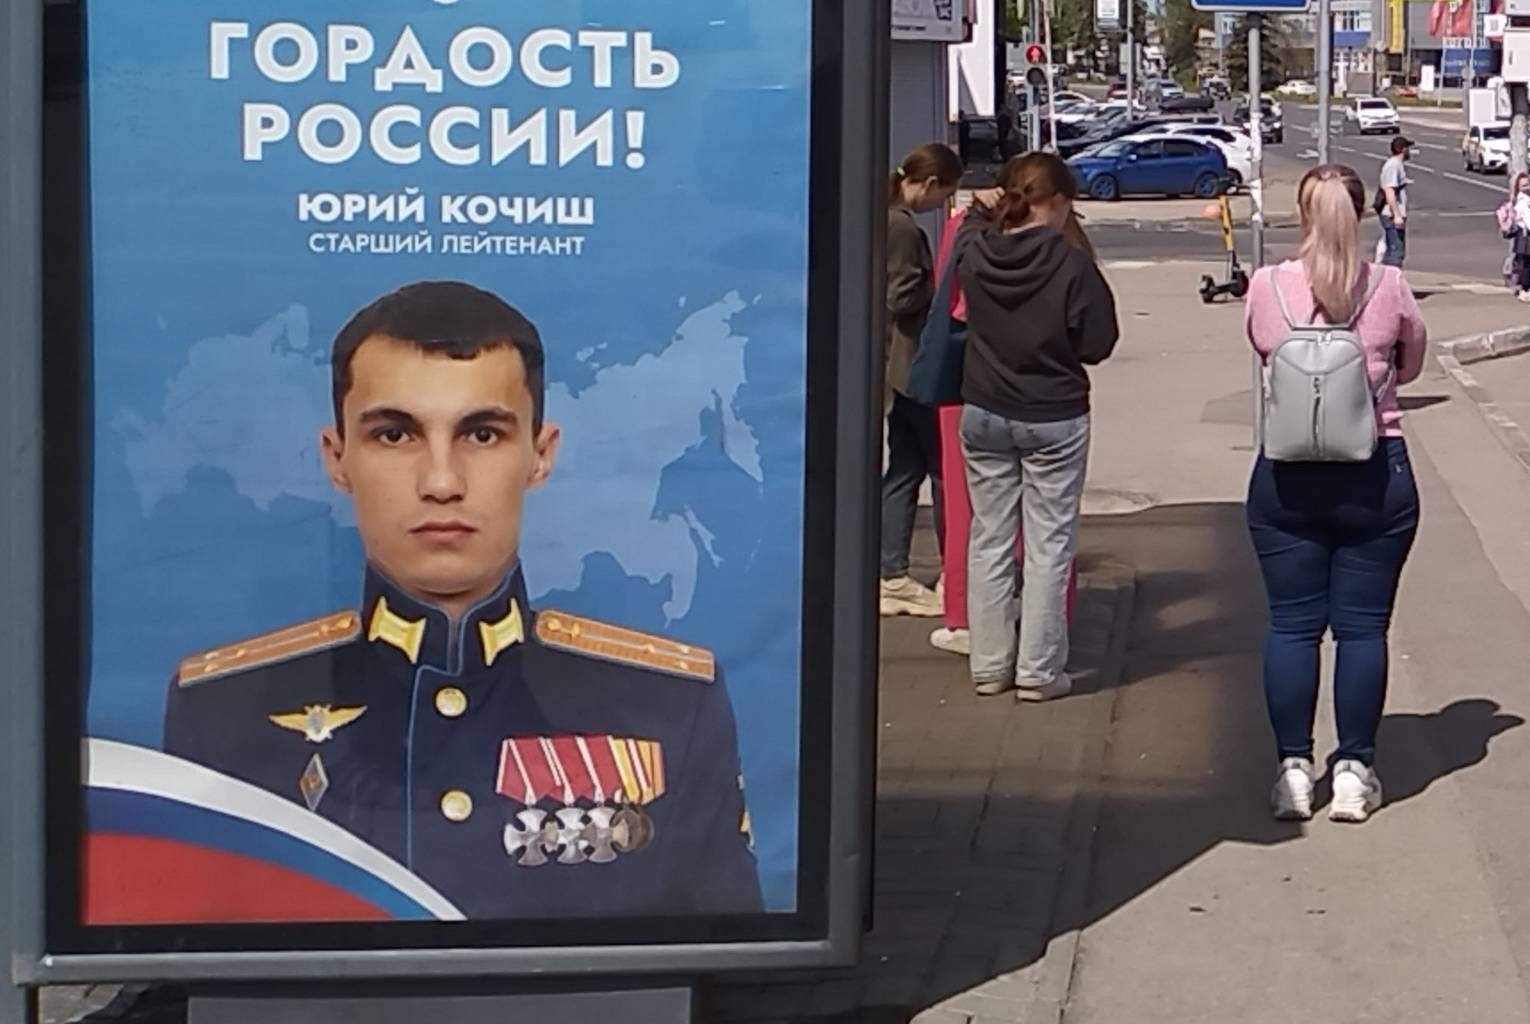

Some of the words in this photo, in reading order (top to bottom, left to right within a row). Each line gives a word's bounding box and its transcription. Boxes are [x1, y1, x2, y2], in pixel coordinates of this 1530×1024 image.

[209, 21, 681, 93] ГОРДОСТЬ
[242, 102, 646, 169] РОССИИ!
[297, 186, 425, 223] ЮРИЙ
[441, 193, 595, 225] КОЧИШ
[309, 229, 433, 254] СТАРШИЙ
[440, 230, 586, 256] ЛЕЙТЕНАНТ
